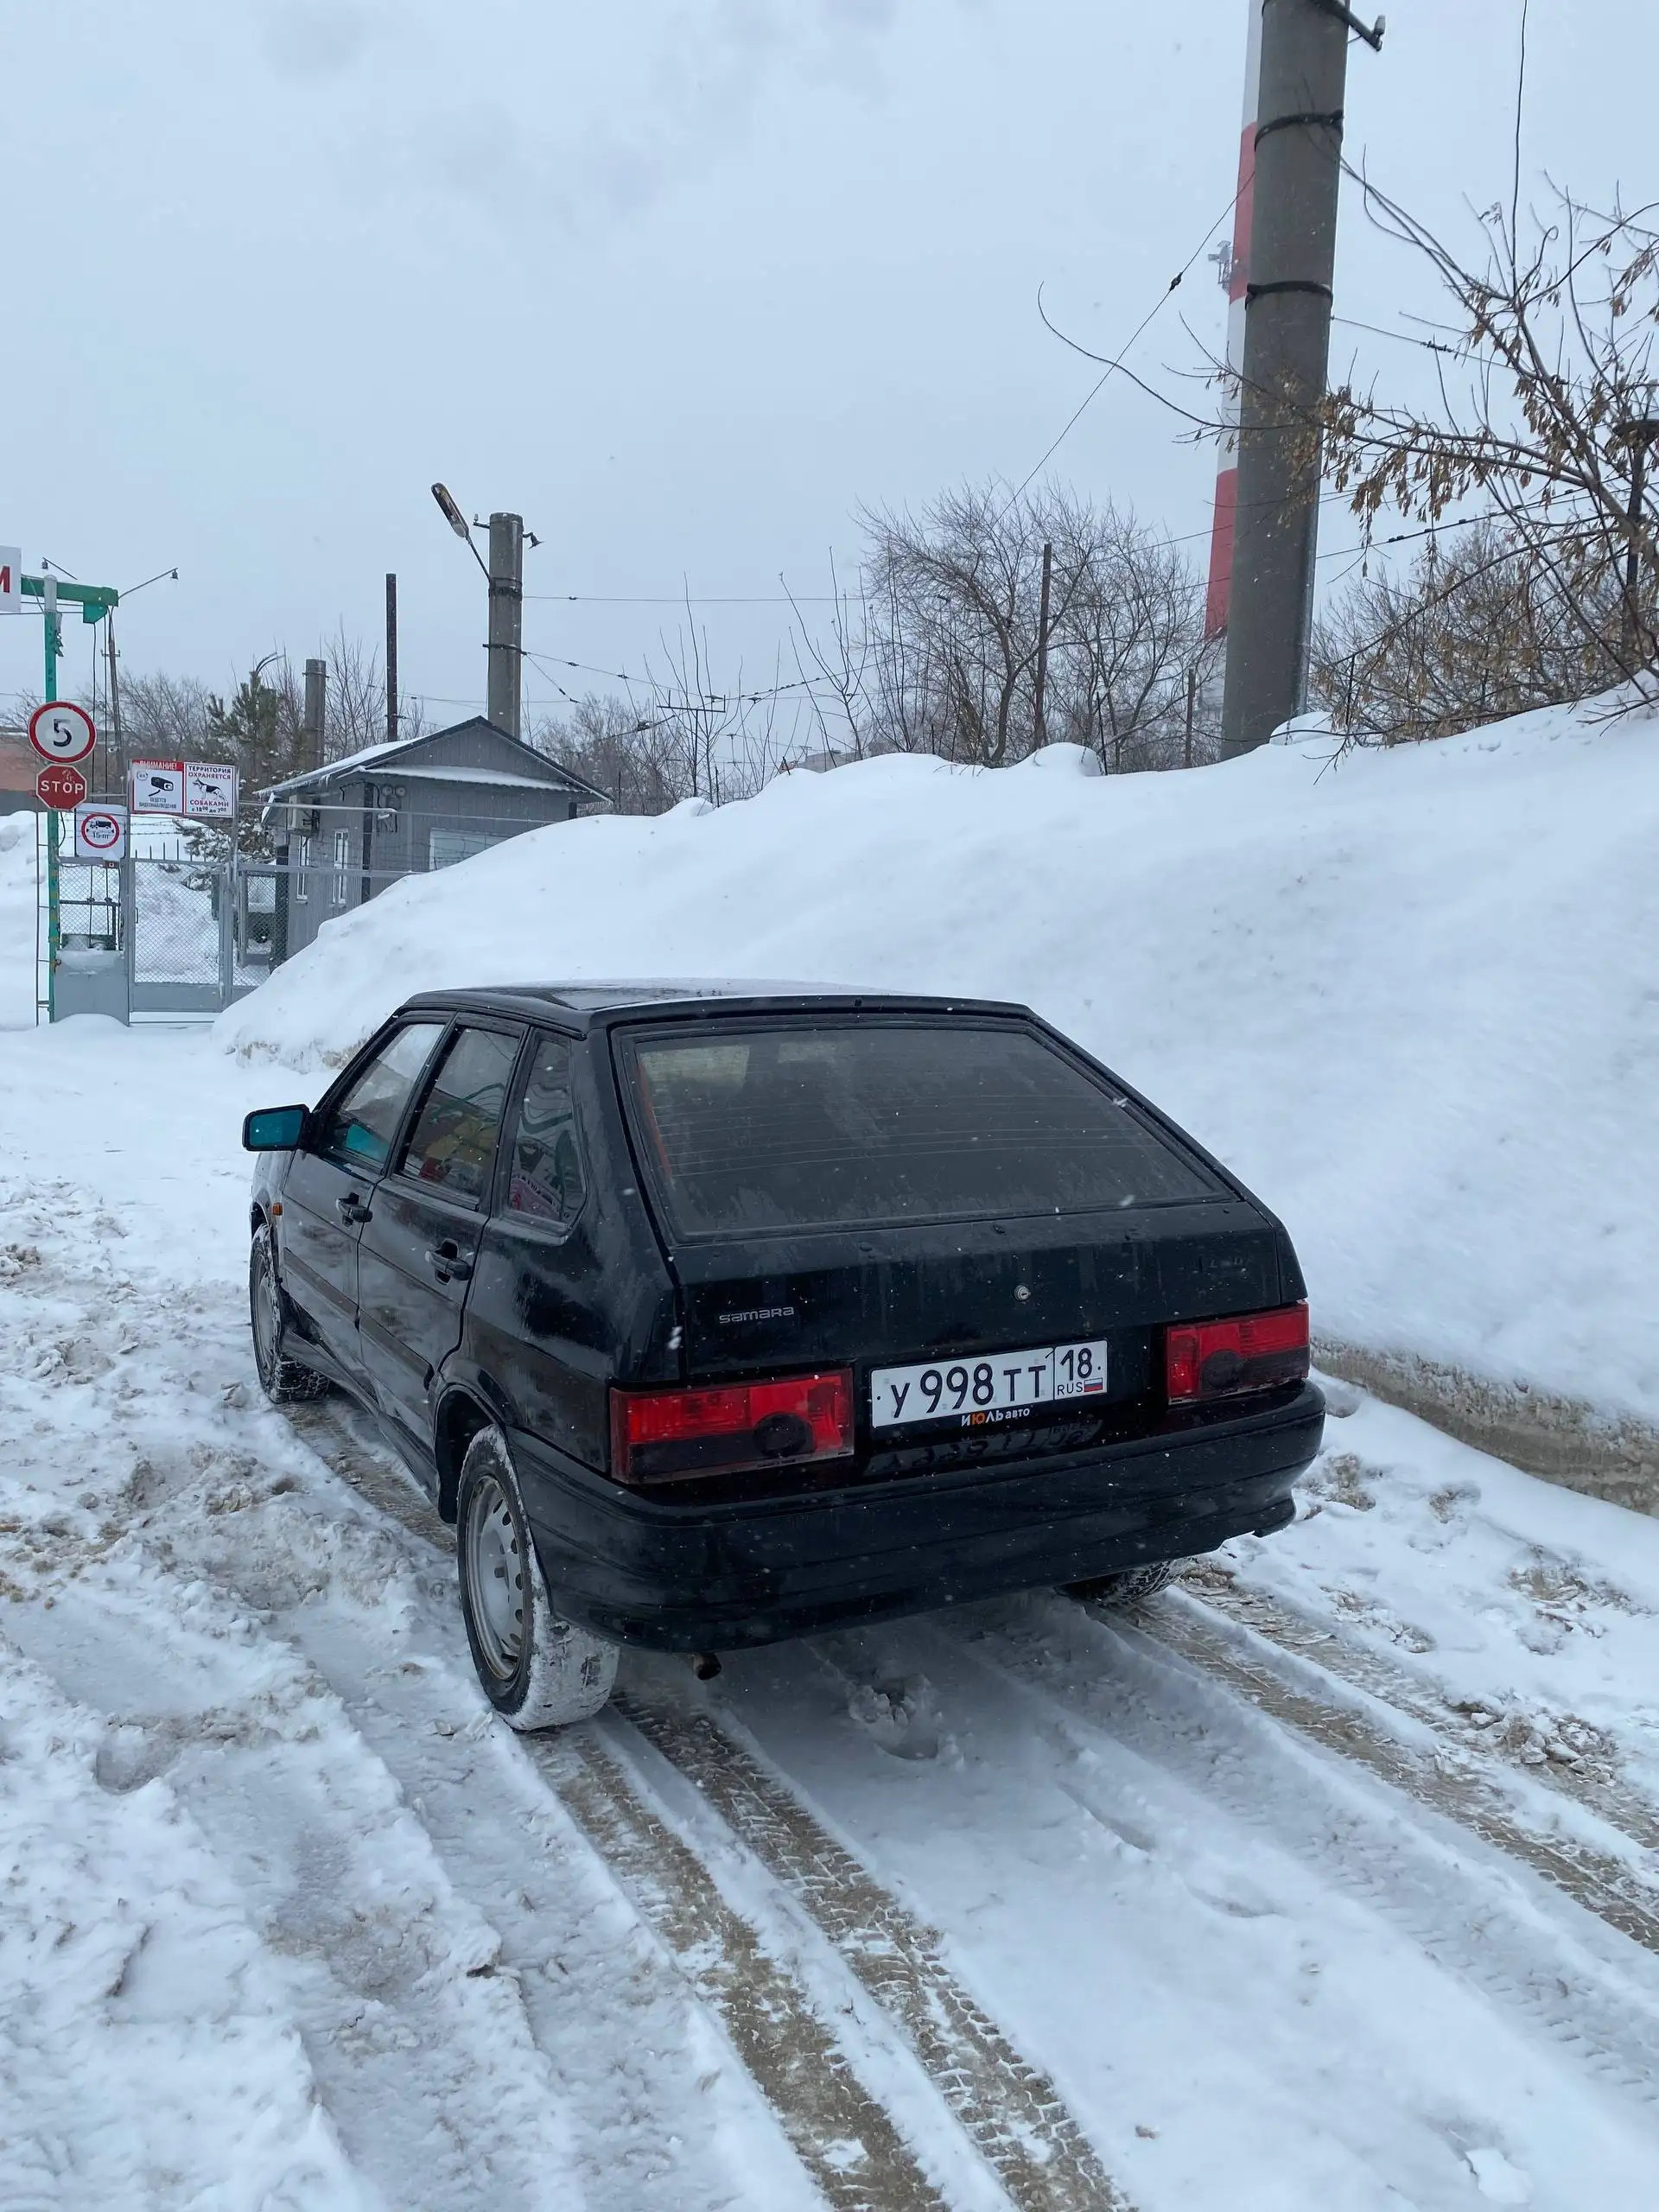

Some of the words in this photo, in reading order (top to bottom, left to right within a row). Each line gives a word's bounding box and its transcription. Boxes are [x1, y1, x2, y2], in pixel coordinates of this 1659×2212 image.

[53, 718, 72, 747] 5
[41, 779, 84, 794] STOP
[1059, 1347, 1093, 1381] 18
[1057, 1382, 1084, 1396] RUS
